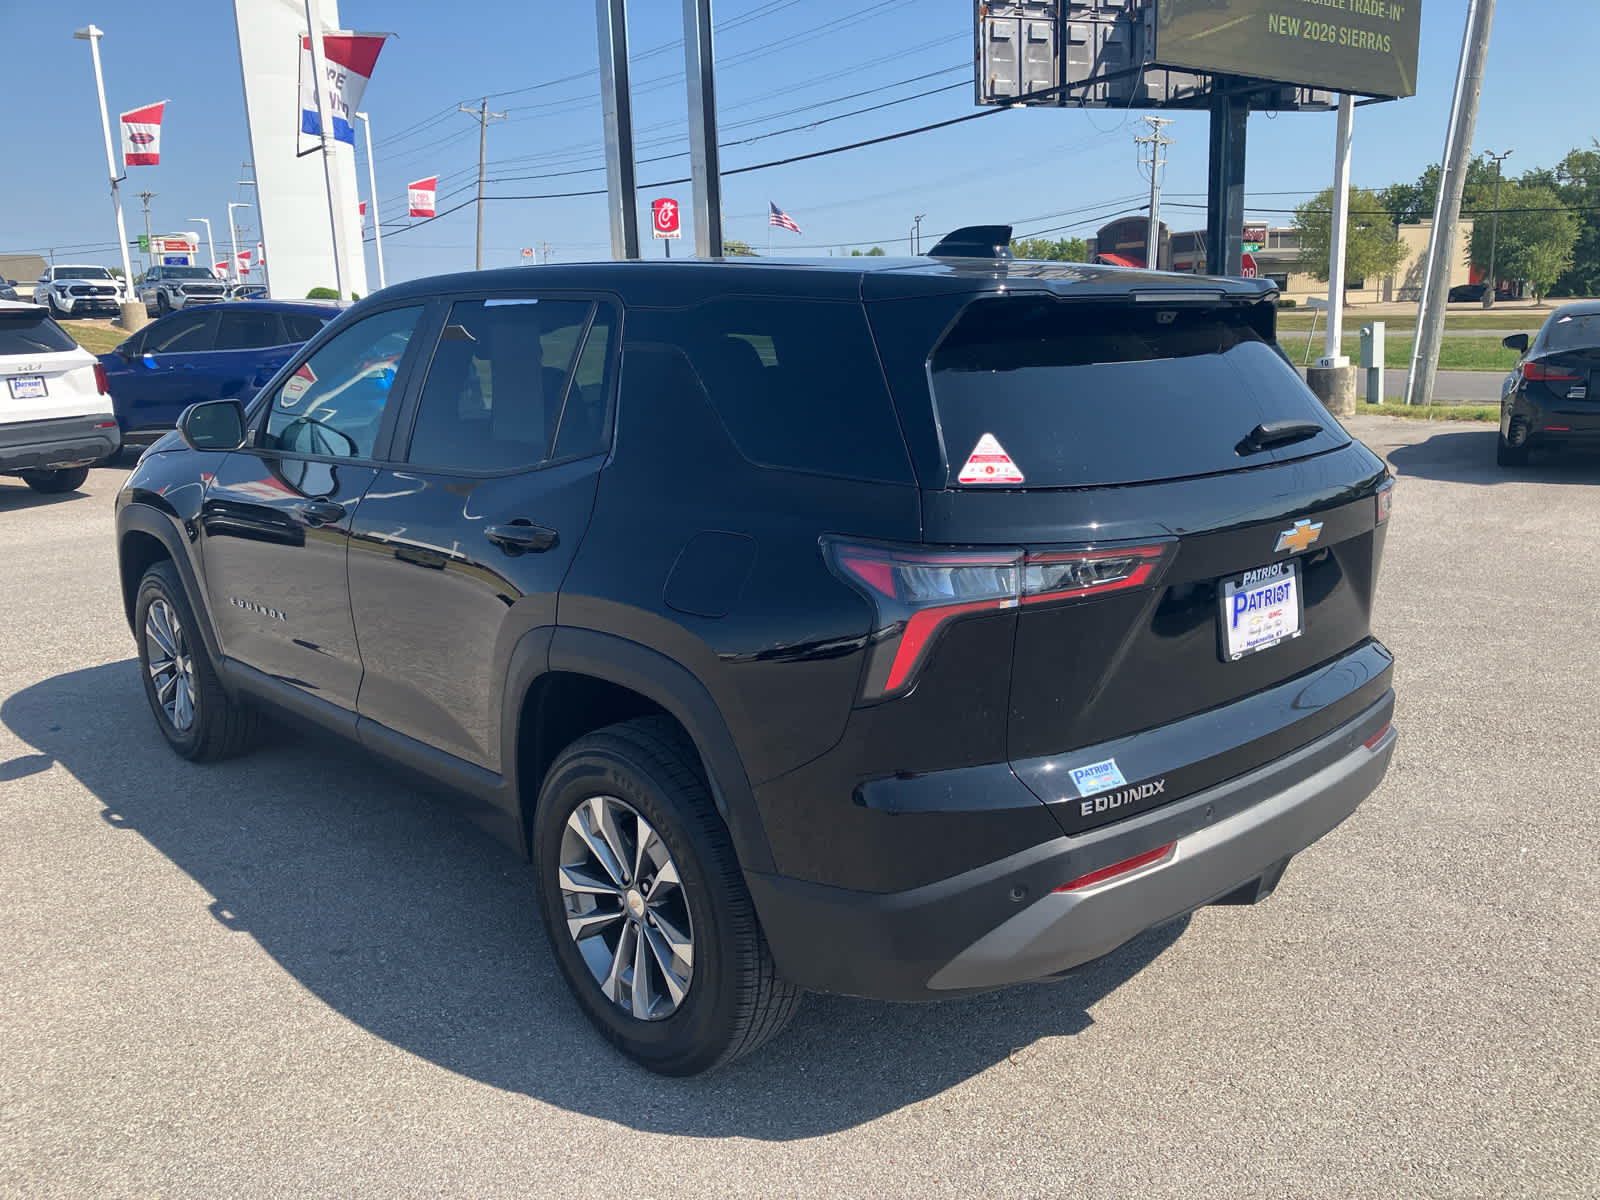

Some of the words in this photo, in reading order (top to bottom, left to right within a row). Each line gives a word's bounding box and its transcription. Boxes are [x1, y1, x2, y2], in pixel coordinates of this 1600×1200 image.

[1268, 14, 1300, 36] NEW
[1303, 20, 1336, 43] 2026
[1339, 28, 1392, 52] SIERRAS
[1242, 267, 1256, 279] OP
[1320, 359, 1329, 367] 10
[1243, 562, 1284, 586] PATRIOT
[229, 596, 287, 622] EQUINOX
[1232, 582, 1291, 628] PATRIOT
[1073, 761, 1114, 785] PATRIOT
[1081, 779, 1165, 817] EQUINOX
